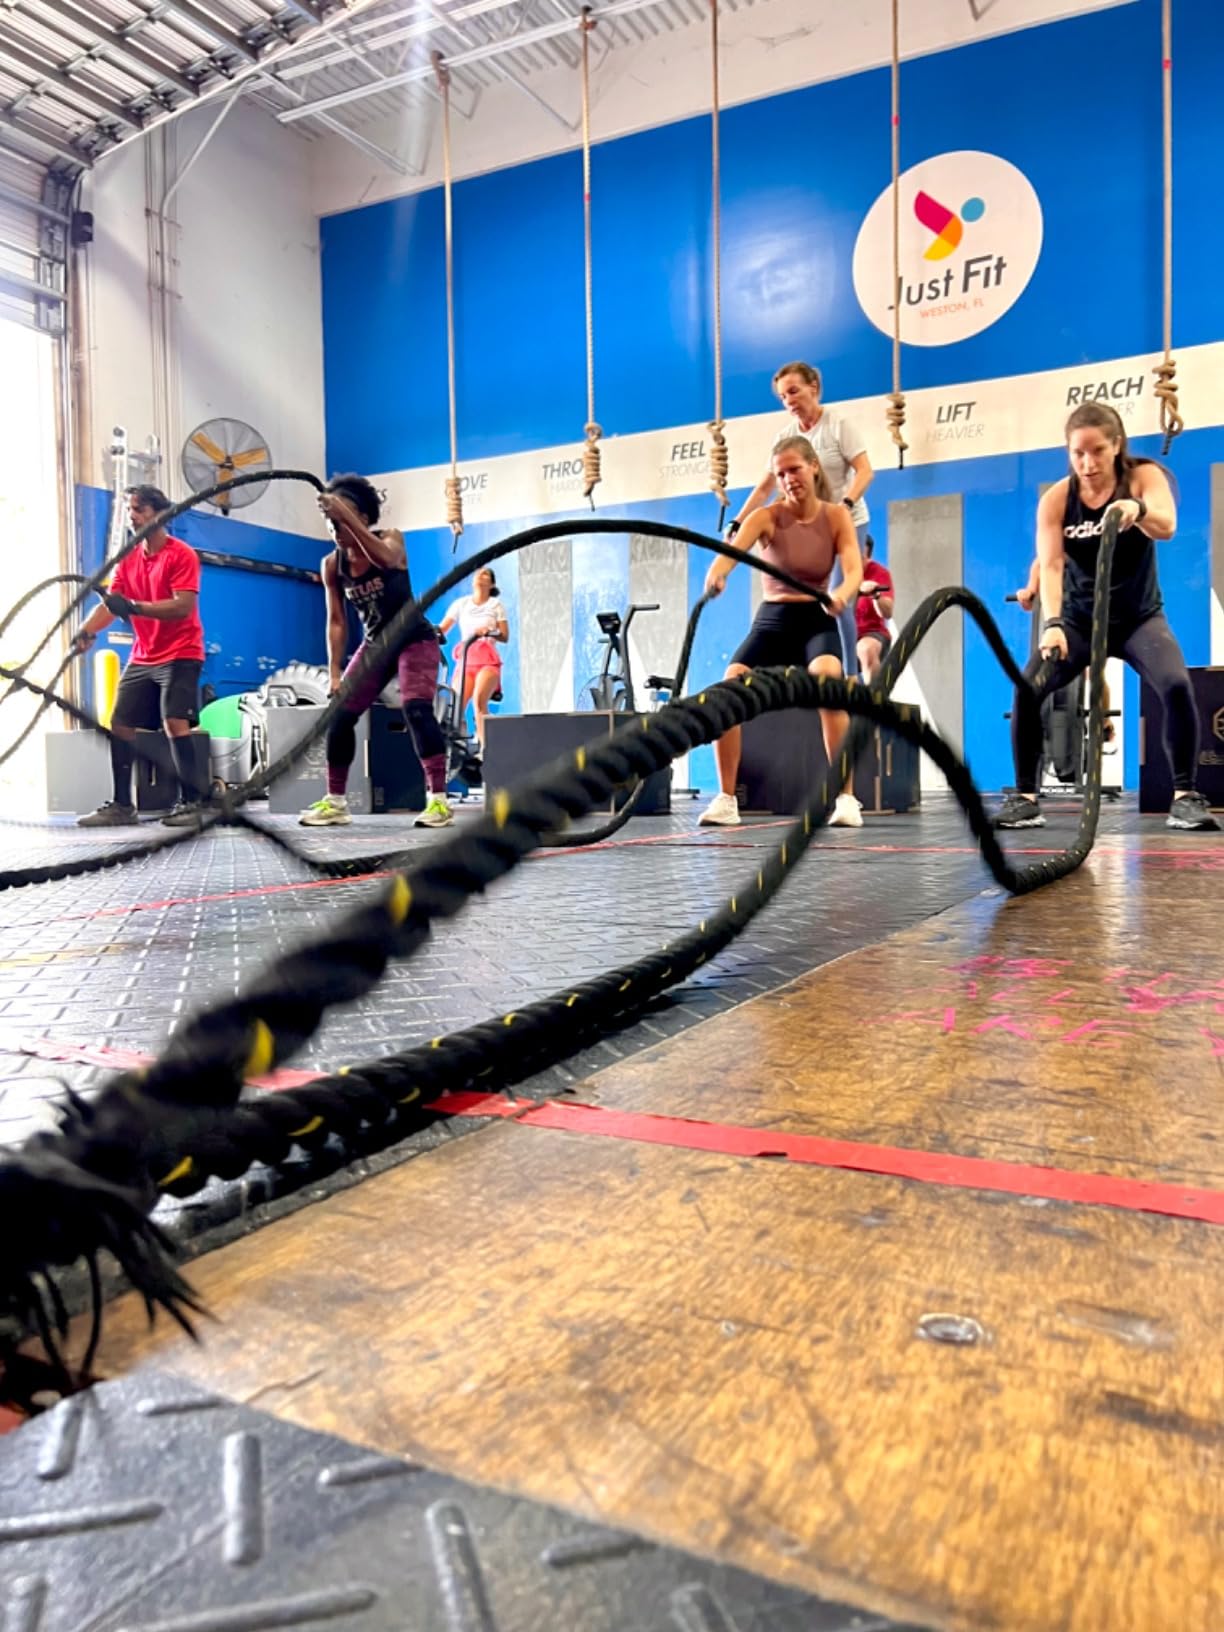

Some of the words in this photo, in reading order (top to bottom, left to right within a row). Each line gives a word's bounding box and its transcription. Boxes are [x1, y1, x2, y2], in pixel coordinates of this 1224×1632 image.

[888, 268, 954, 310] Just
[962, 254, 1007, 293] Fit
[974, 298, 984, 308] FL
[1066, 375, 1144, 406] REACH
[936, 401, 976, 424] LIFT
[925, 423, 985, 444] HEAVIER
[671, 440, 706, 462] FEEL
[542, 458, 585, 480] THRO
[459, 472, 488, 493] OVE
